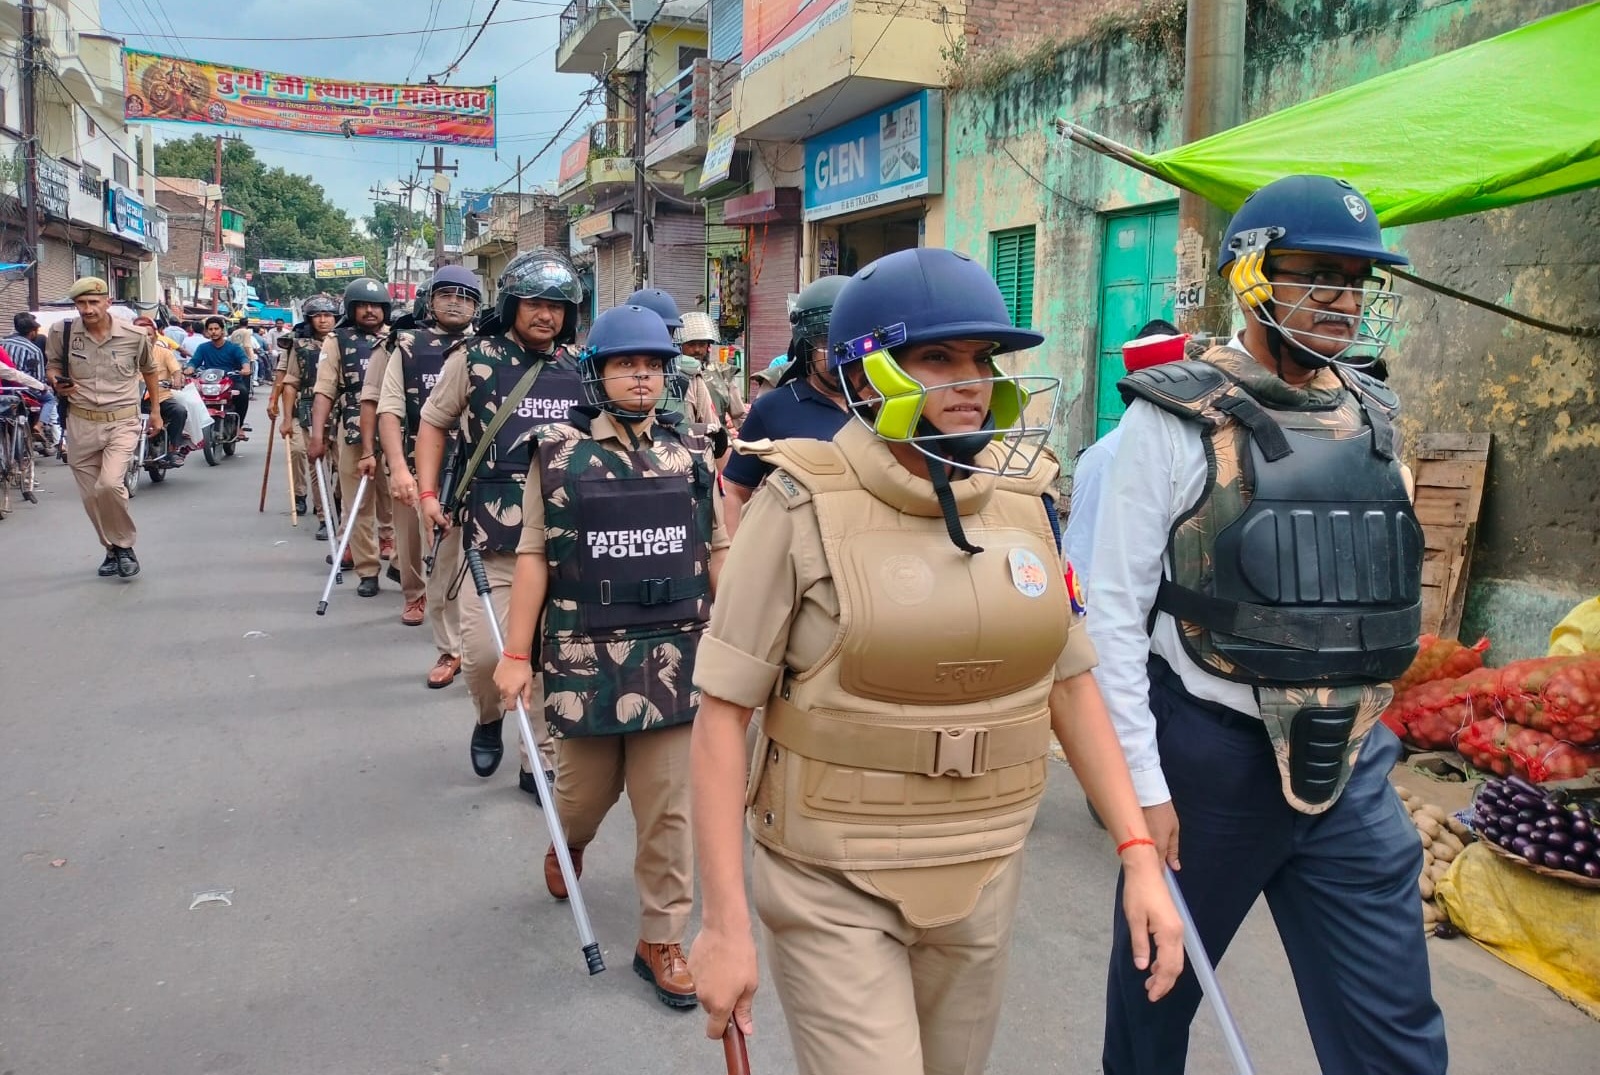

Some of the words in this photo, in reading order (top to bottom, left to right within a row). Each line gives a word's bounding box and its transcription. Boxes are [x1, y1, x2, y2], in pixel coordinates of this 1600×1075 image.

[216, 70, 264, 94] दुर्गा
[271, 75, 307, 96] जी
[314, 81, 394, 103] स्थापना
[402, 85, 487, 110] महोत्सव
[814, 136, 865, 190] GLEN
[855, 192, 879, 208] TRADERS
[586, 525, 687, 546] FATEHGARH
[591, 540, 683, 559] POLICE
